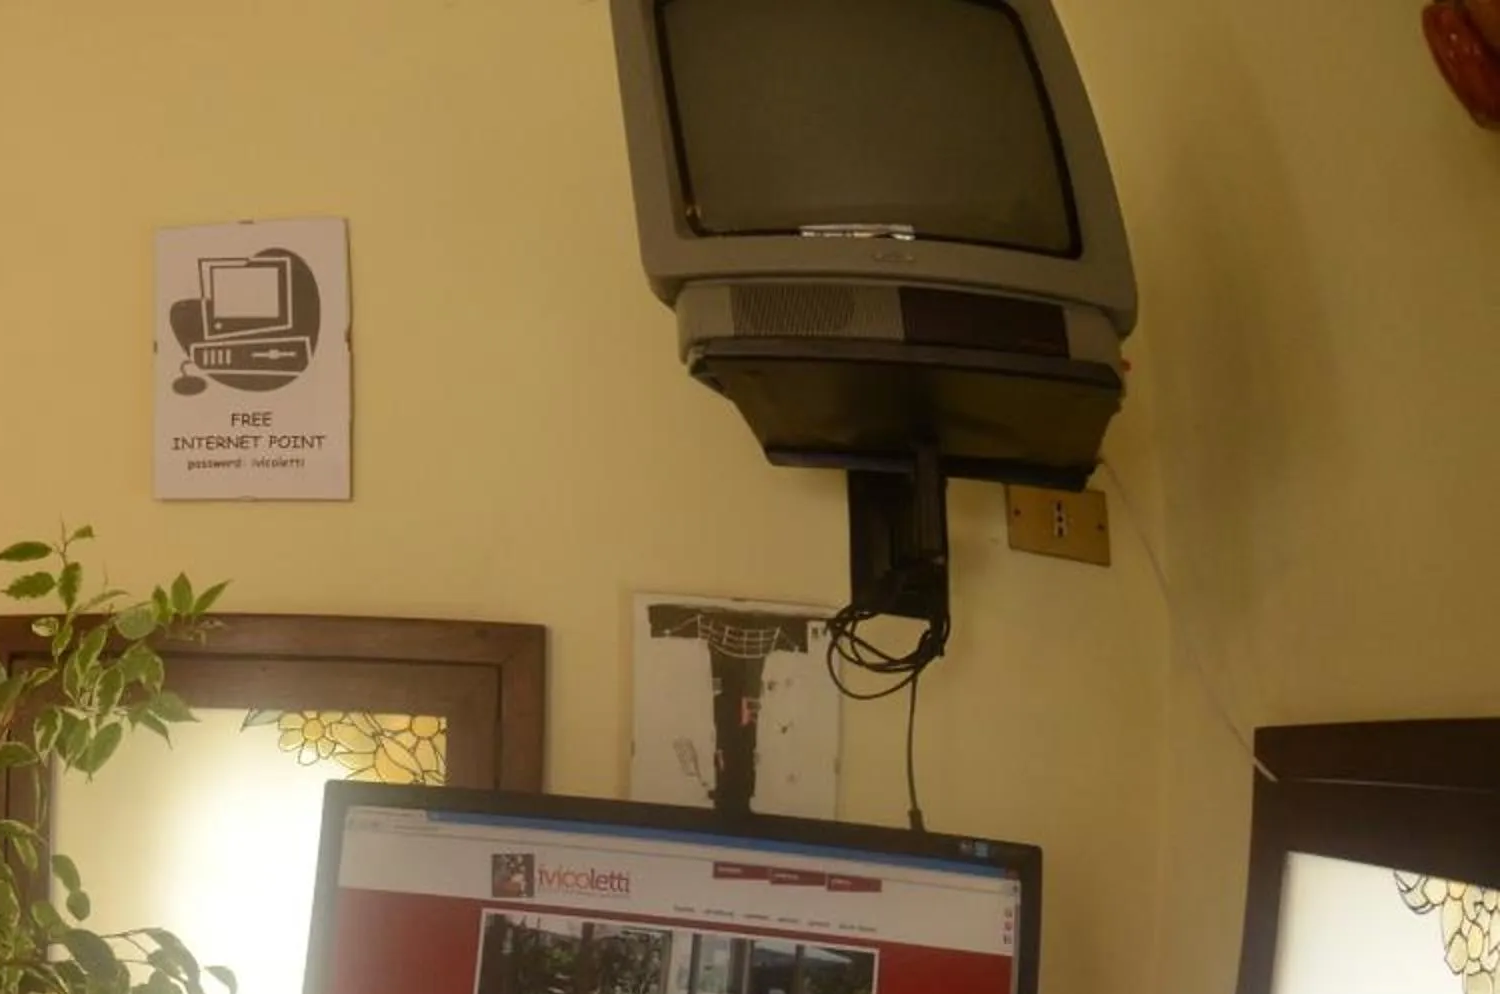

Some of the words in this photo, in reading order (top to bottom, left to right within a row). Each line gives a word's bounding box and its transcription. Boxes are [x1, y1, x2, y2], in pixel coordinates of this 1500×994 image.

[230, 411, 273, 428] FREE
[171, 435, 262, 451] INTERNET
[268, 434, 326, 450] POINT
